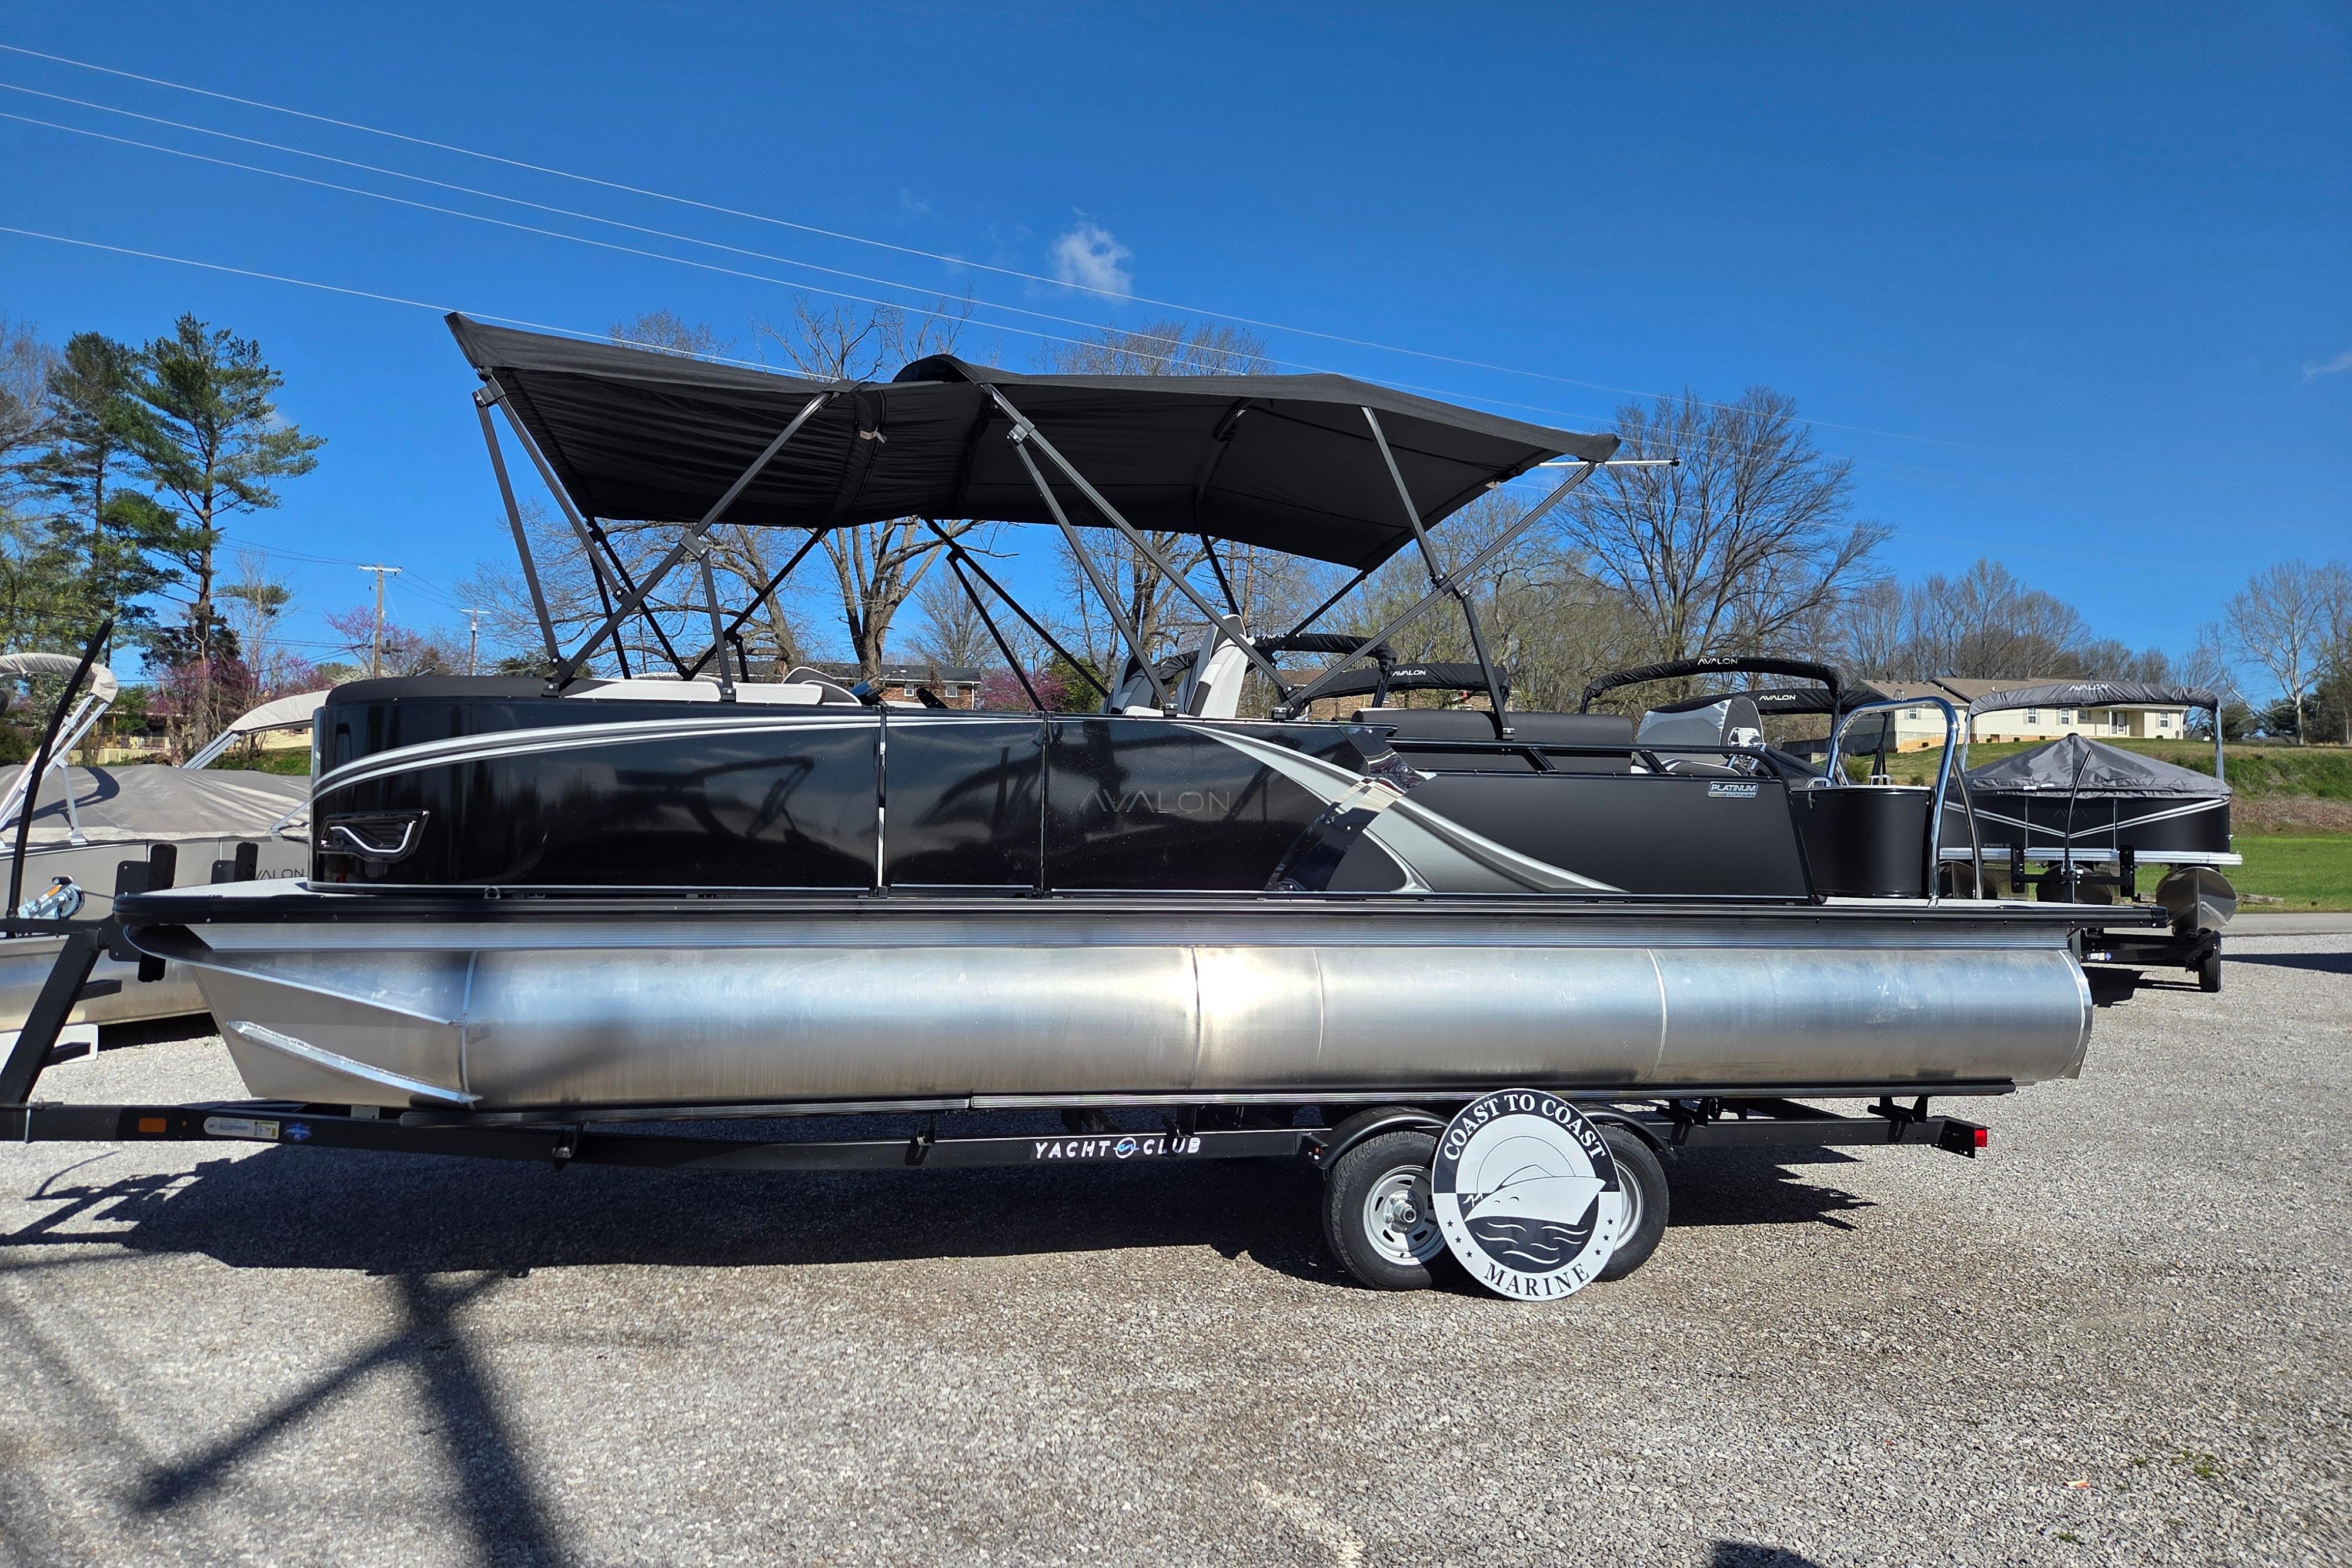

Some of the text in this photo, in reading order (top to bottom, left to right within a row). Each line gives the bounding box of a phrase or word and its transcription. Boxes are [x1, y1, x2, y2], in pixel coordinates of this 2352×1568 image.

[1078, 789, 1231, 814] AVALON
[256, 868, 304, 880] VALON
[1444, 1094, 1606, 1161] COAST TO COAST
[1035, 1137, 1201, 1159] YACHT CLUB
[1484, 1263, 1590, 1296] MARINE
